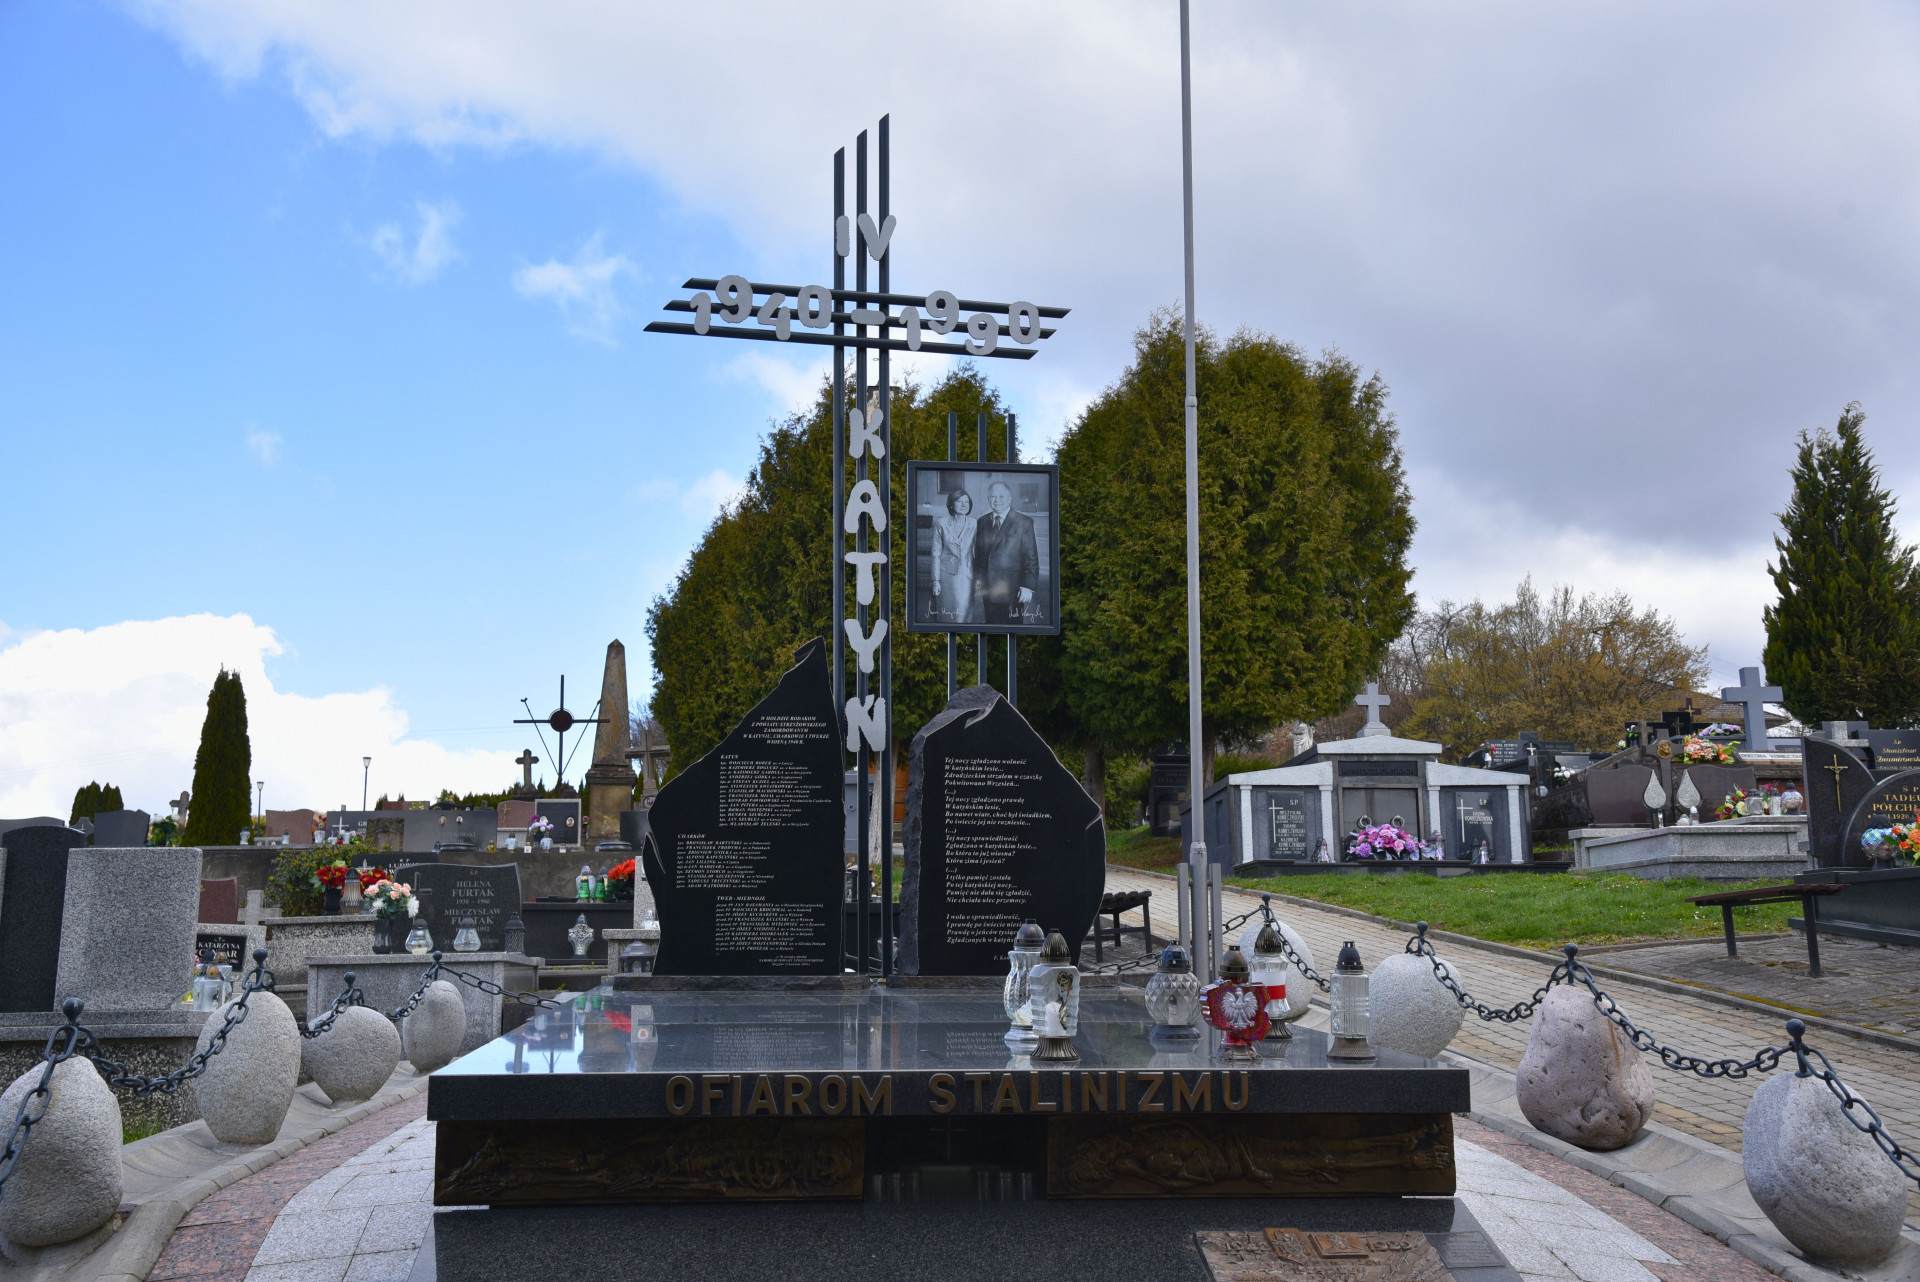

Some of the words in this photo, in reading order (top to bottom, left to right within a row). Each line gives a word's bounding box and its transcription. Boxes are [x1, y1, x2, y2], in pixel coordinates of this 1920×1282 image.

[835, 213, 897, 261] IV
[664, 1074, 892, 1116] OFIAROM
[928, 1071, 1248, 1113] STALINIZMU
